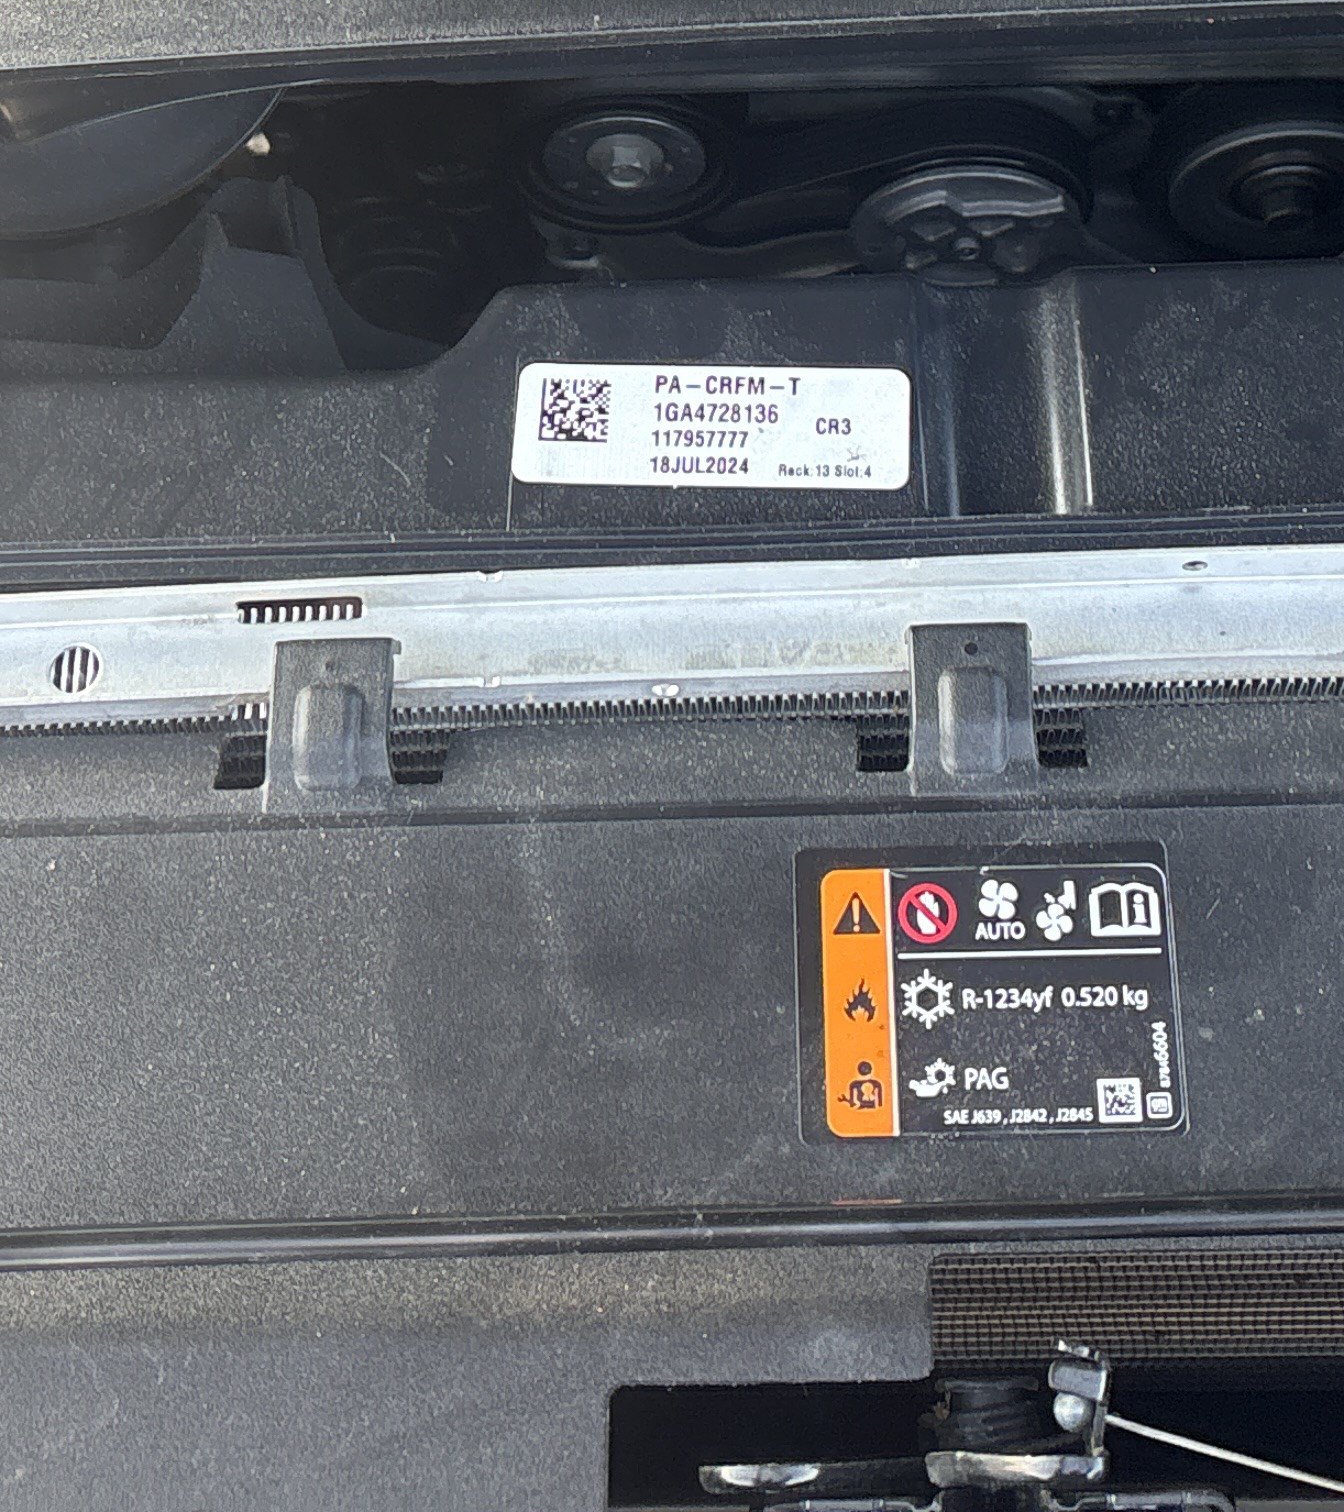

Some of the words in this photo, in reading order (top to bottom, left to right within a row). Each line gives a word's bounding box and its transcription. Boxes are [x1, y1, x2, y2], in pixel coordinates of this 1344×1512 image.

[655, 375, 801, 397] PA-CRFM-T
[653, 402, 779, 424] 1GA4728136
[815, 418, 852, 436] CR3
[651, 430, 749, 449] 117957777
[650, 456, 749, 475] 18JUL2024
[975, 921, 1025, 941] AUTO
[962, 985, 1054, 1013] R-1234yf
[1061, 986, 1118, 1008] 0.520
[1122, 986, 1149, 1011] kg
[964, 1067, 1010, 1090] PAG
[943, 1109, 969, 1125] SAE
[1056, 1107, 1094, 1123] J2845
